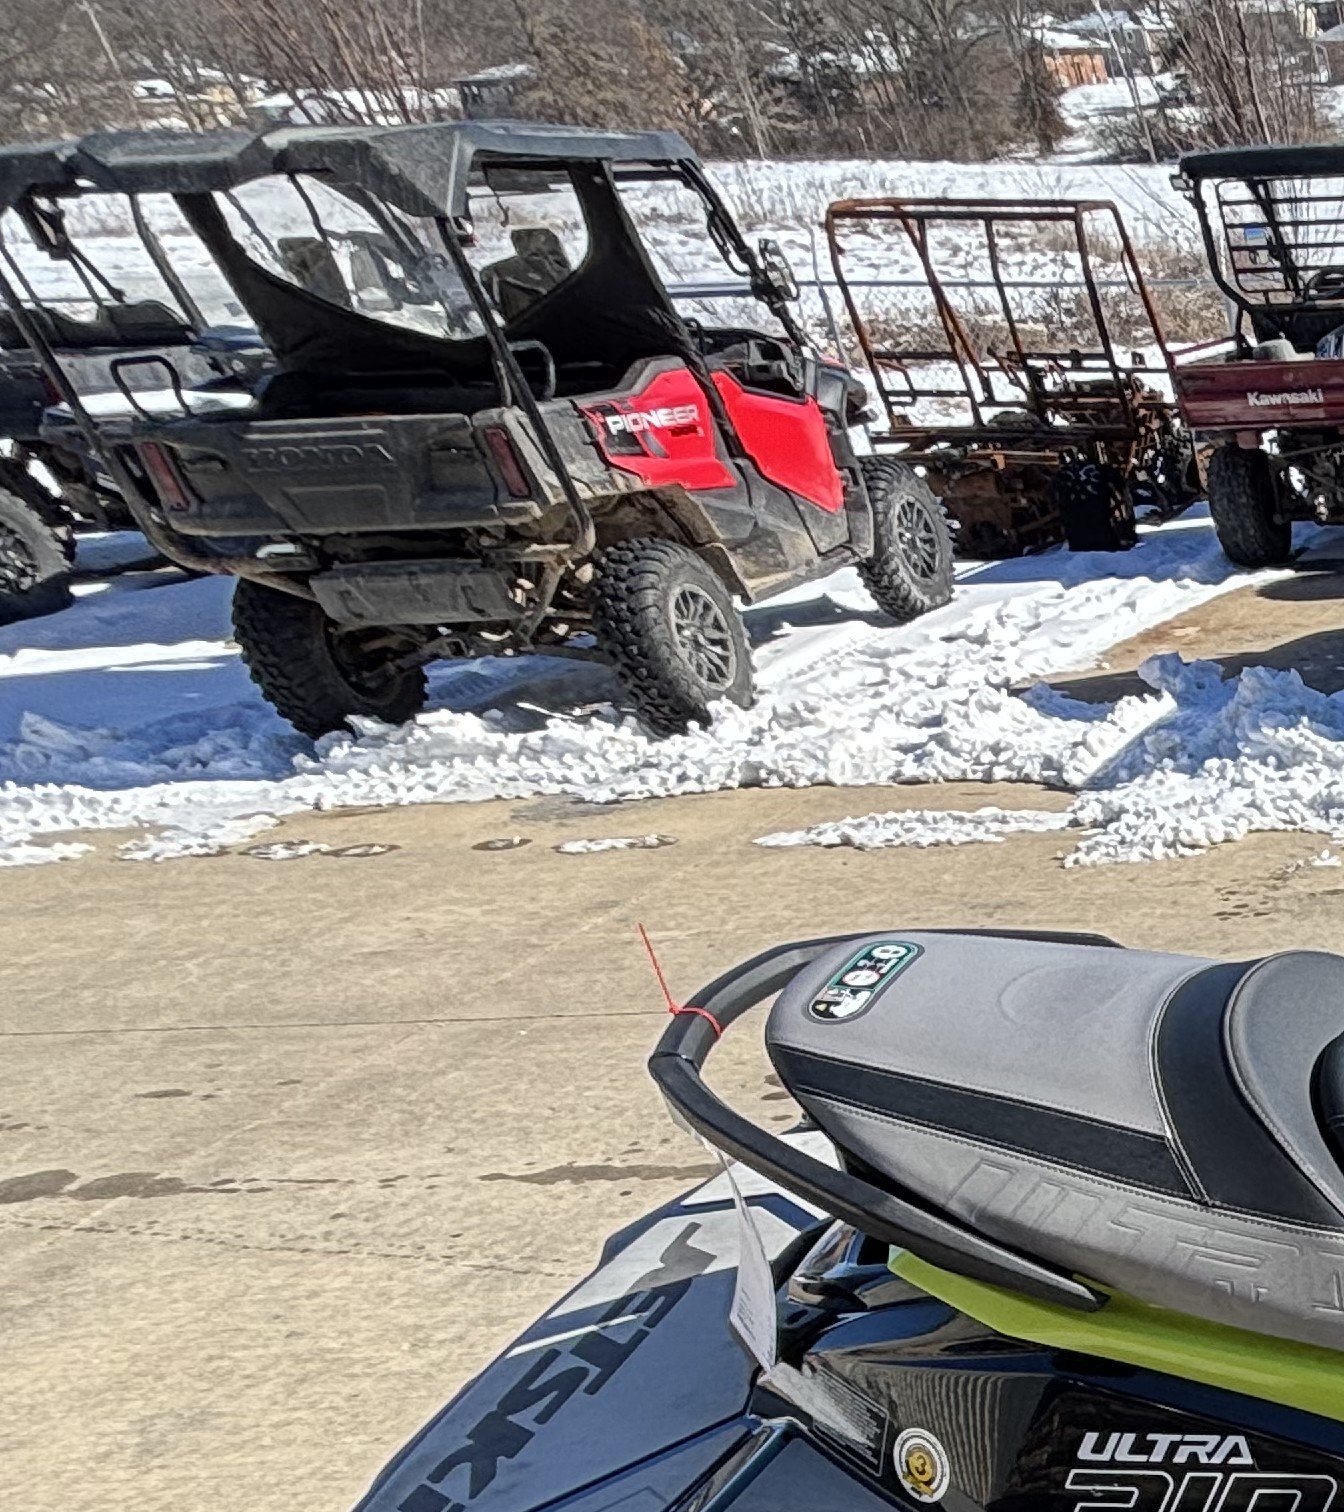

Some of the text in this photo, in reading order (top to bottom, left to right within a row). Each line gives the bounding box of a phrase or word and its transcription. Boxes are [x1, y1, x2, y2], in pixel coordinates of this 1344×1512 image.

[1246, 388, 1325, 407] Kawasaki
[605, 403, 700, 436] PIONEER
[1076, 1431, 1255, 1464] ULTRA
